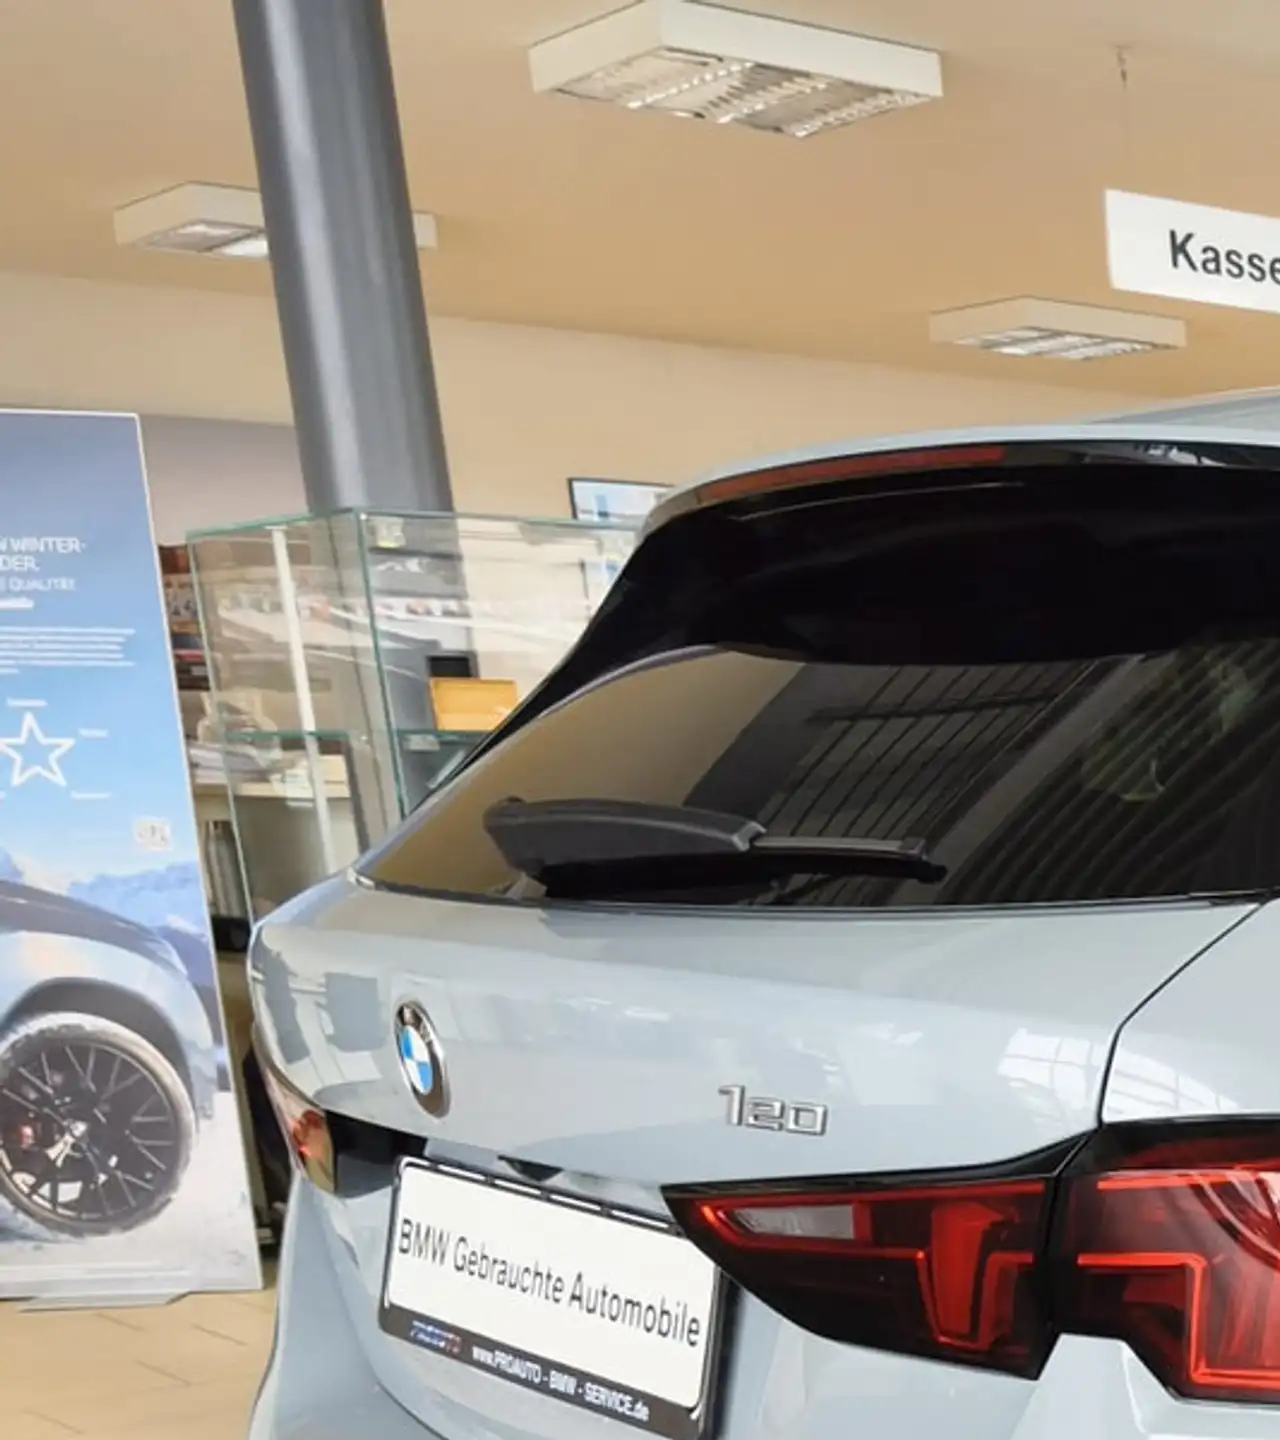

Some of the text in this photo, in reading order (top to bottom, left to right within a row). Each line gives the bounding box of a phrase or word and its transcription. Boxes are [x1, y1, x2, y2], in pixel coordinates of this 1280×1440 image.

[717, 1084, 829, 1136] 120
[397, 1217, 701, 1348] BMW Gebrauchte Automobile
